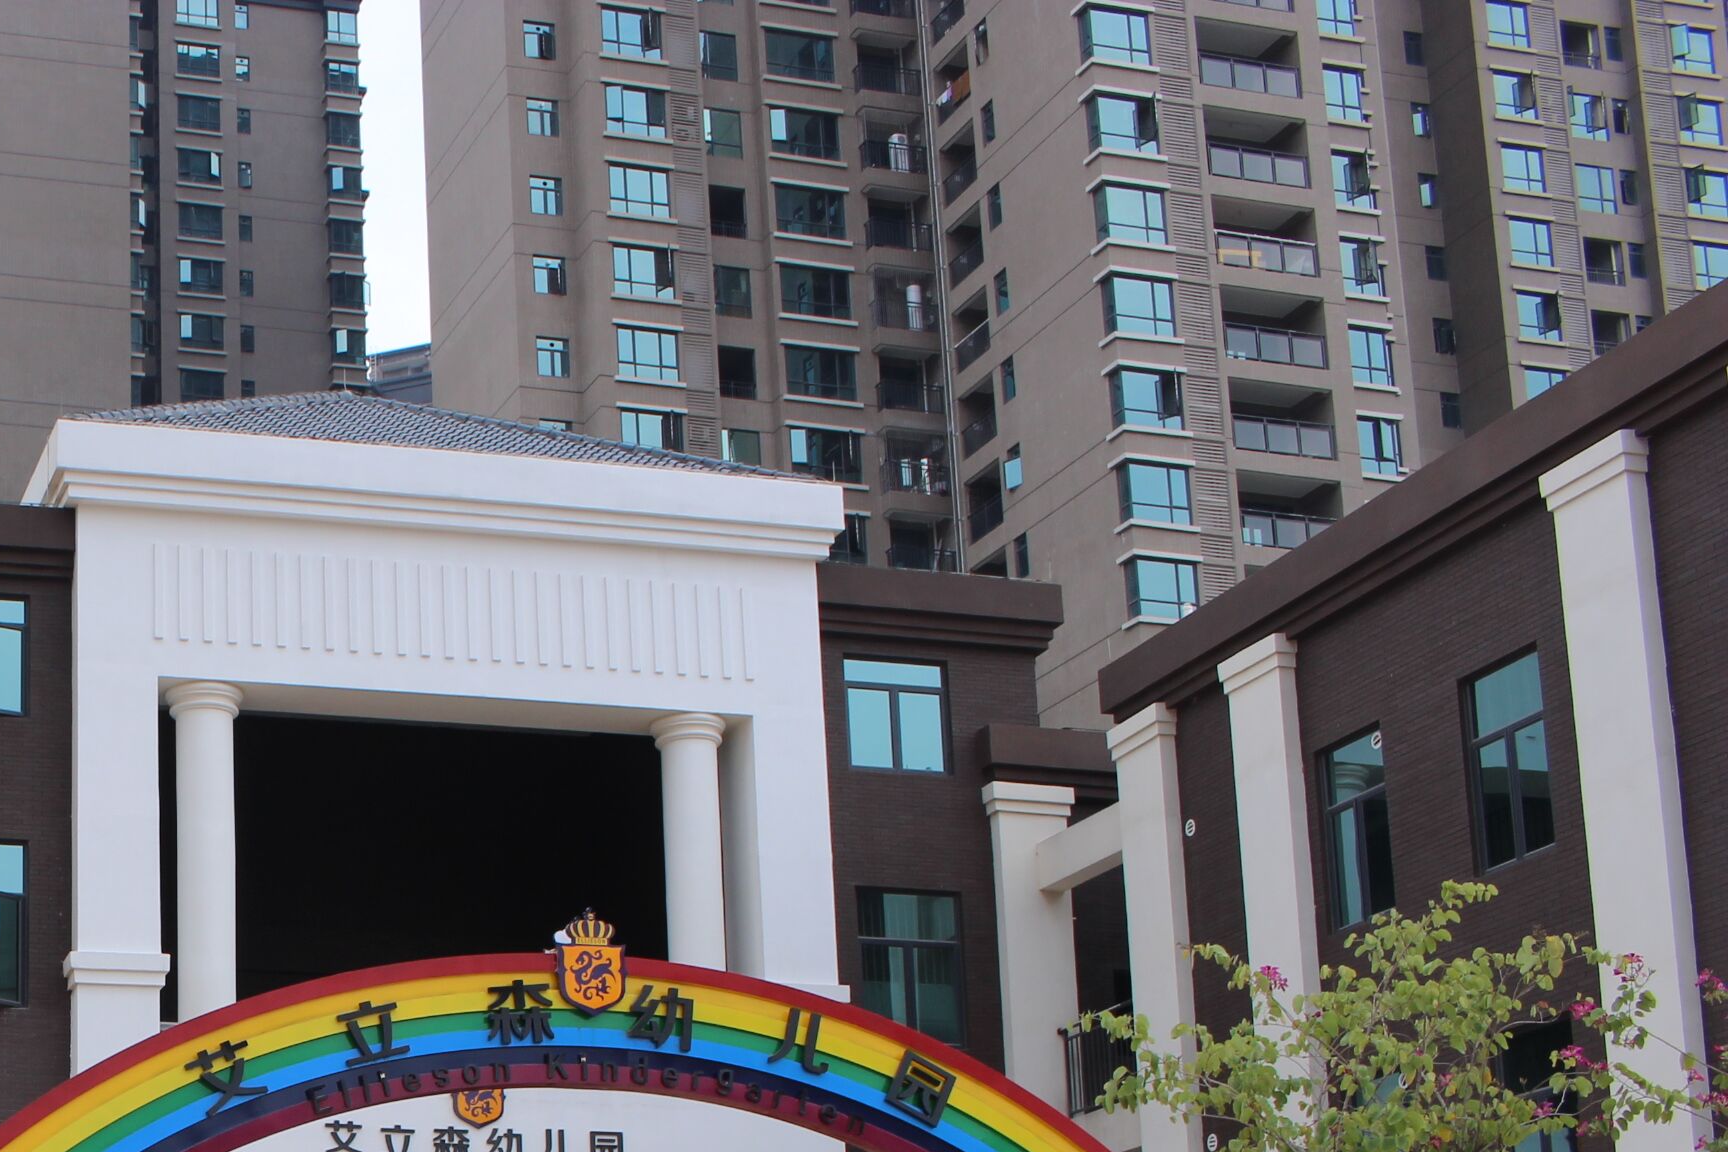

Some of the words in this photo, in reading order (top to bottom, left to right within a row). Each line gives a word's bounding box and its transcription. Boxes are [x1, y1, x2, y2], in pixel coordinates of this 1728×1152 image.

[184, 980, 957, 1128] 艾立森幼儿园
[306, 1061, 511, 1116] Ellieson
[544, 1053, 866, 1136] Kindergarten
